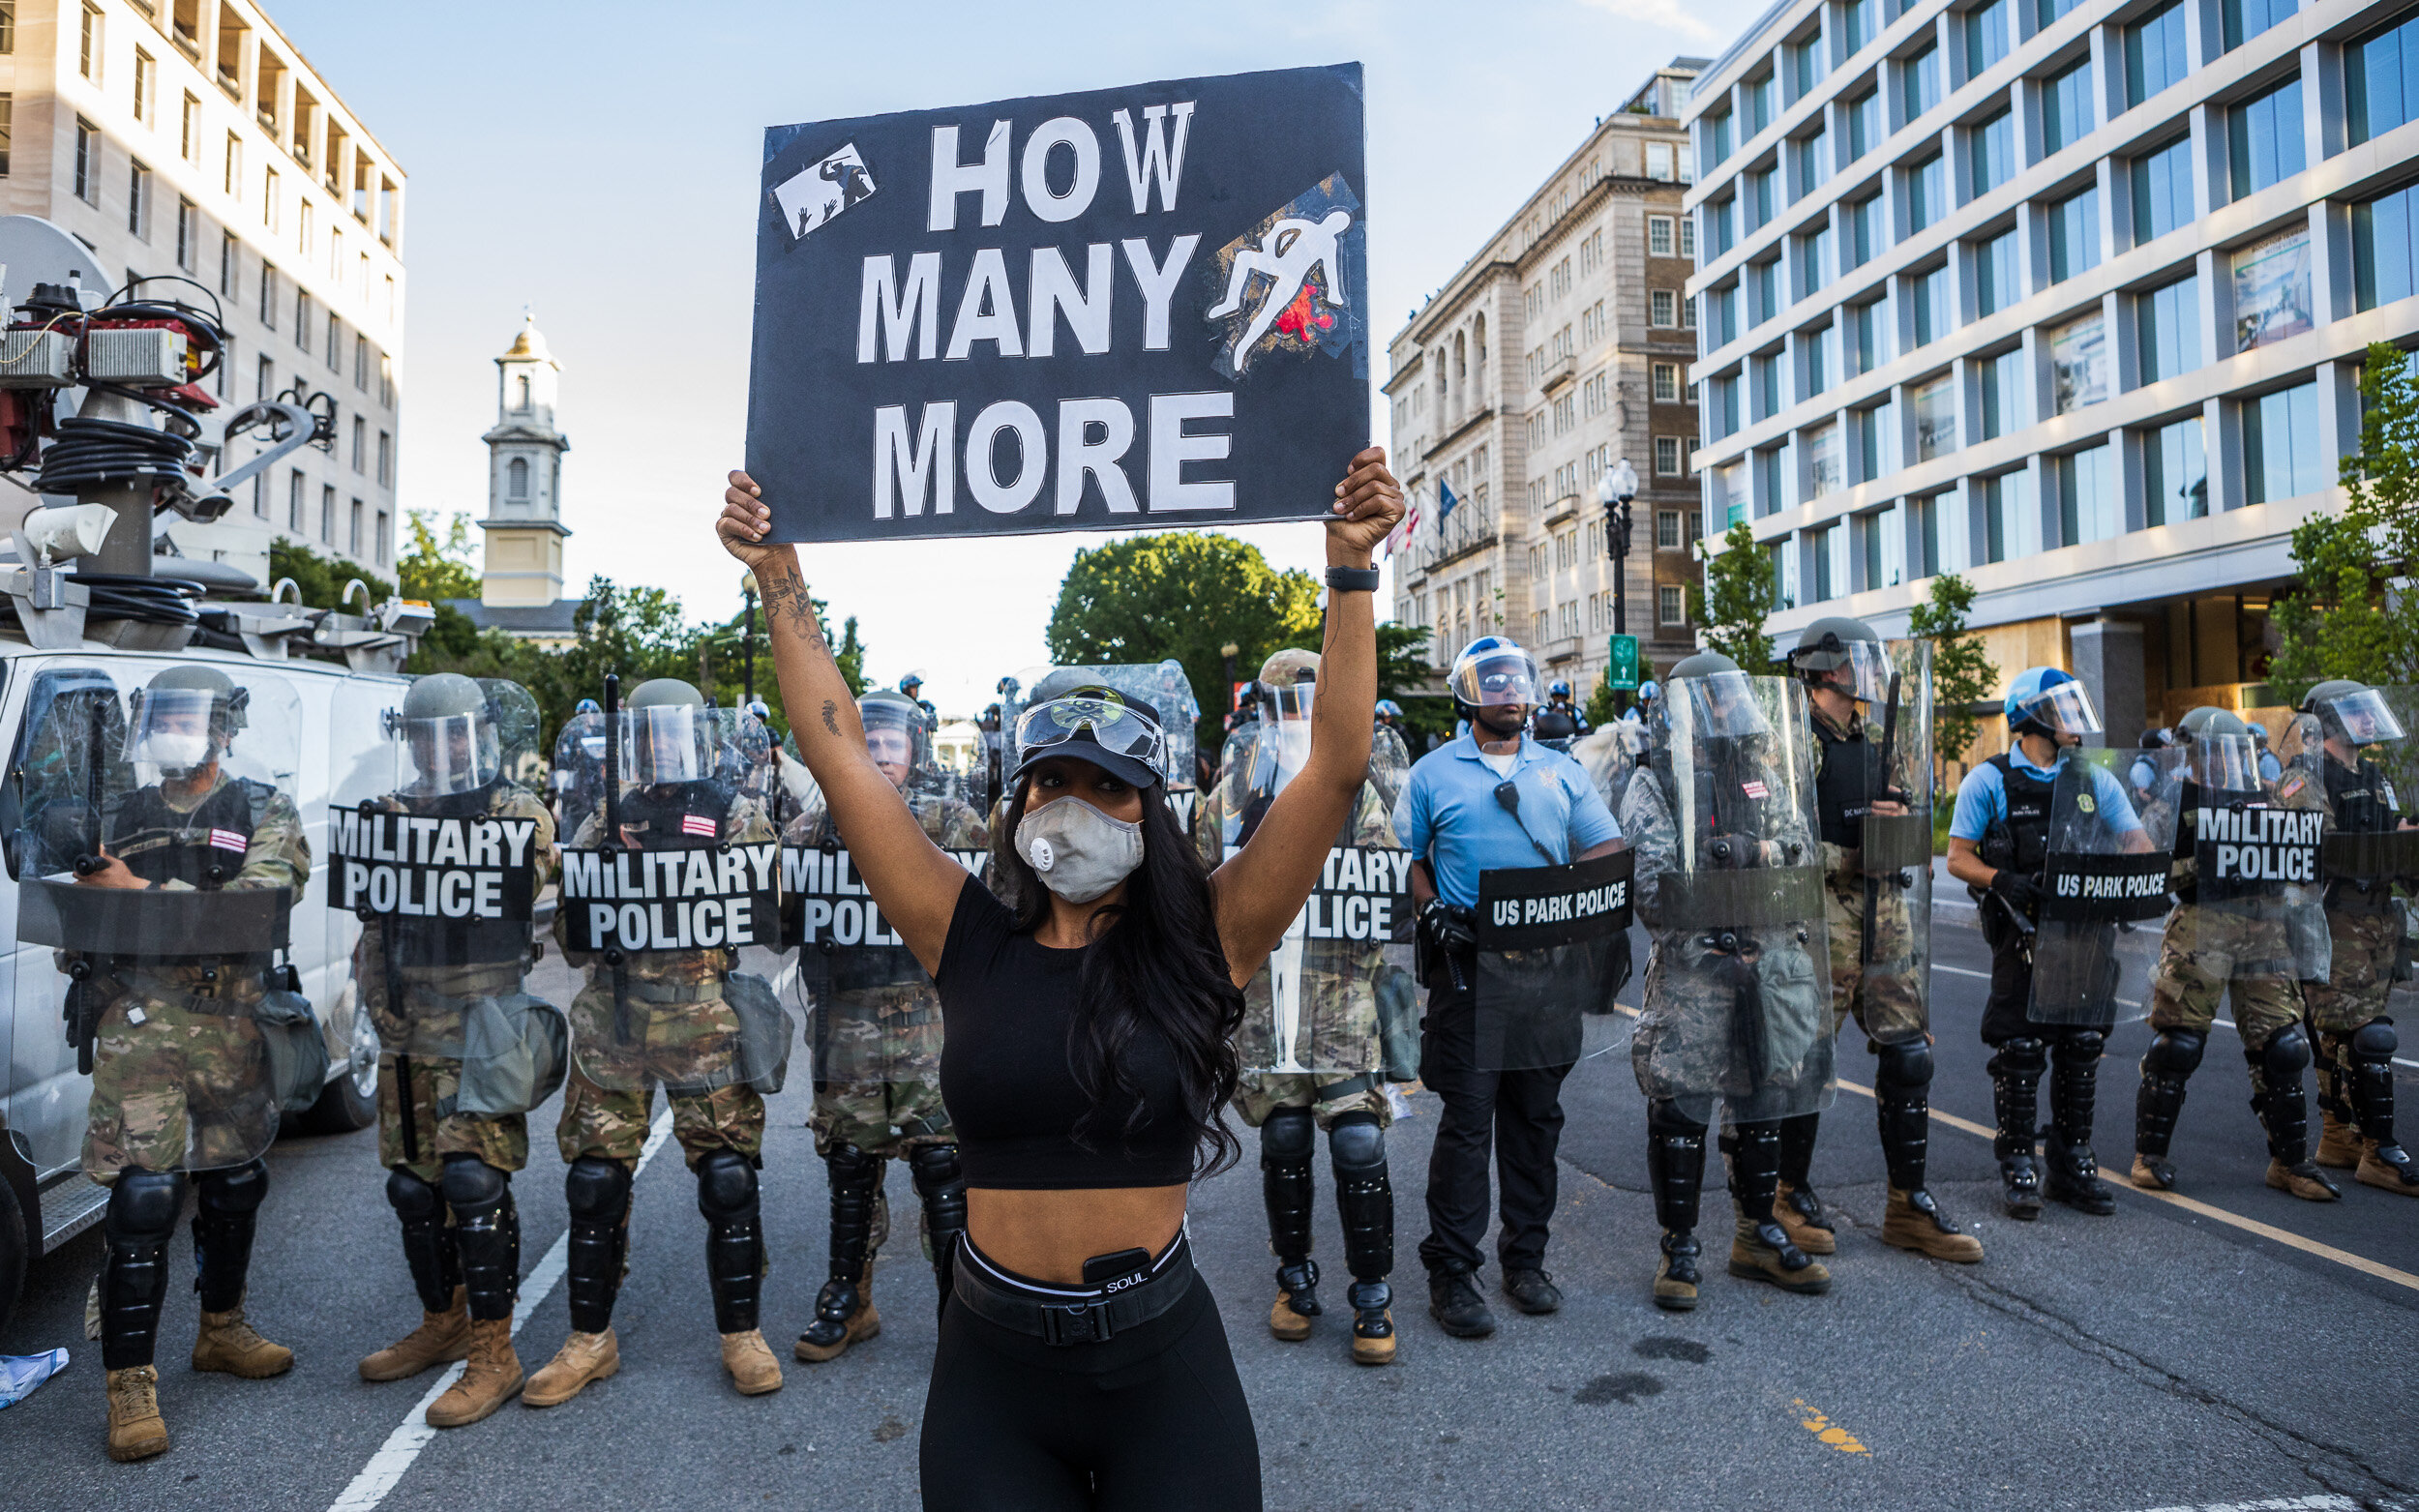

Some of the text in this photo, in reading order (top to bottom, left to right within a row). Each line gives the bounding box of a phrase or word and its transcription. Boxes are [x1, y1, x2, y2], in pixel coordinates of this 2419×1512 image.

[927, 101, 1195, 231] HOW
[856, 233, 1202, 363] MANY
[874, 391, 1236, 519] MORE
[329, 808, 535, 868] MILITARY
[2197, 807, 2323, 845] MILITARY
[562, 845, 776, 899] MILITARY
[2057, 872, 2166, 898] US PARK POLICE
[2217, 845, 2314, 881] POLICE
[344, 862, 503, 918] POLICE
[1493, 880, 1627, 926] US PARK POLICE
[588, 897, 754, 950] POLICE
[804, 899, 904, 946] POL
[1281, 894, 1392, 940] LICE
[1106, 1272, 1149, 1293] SOUL
